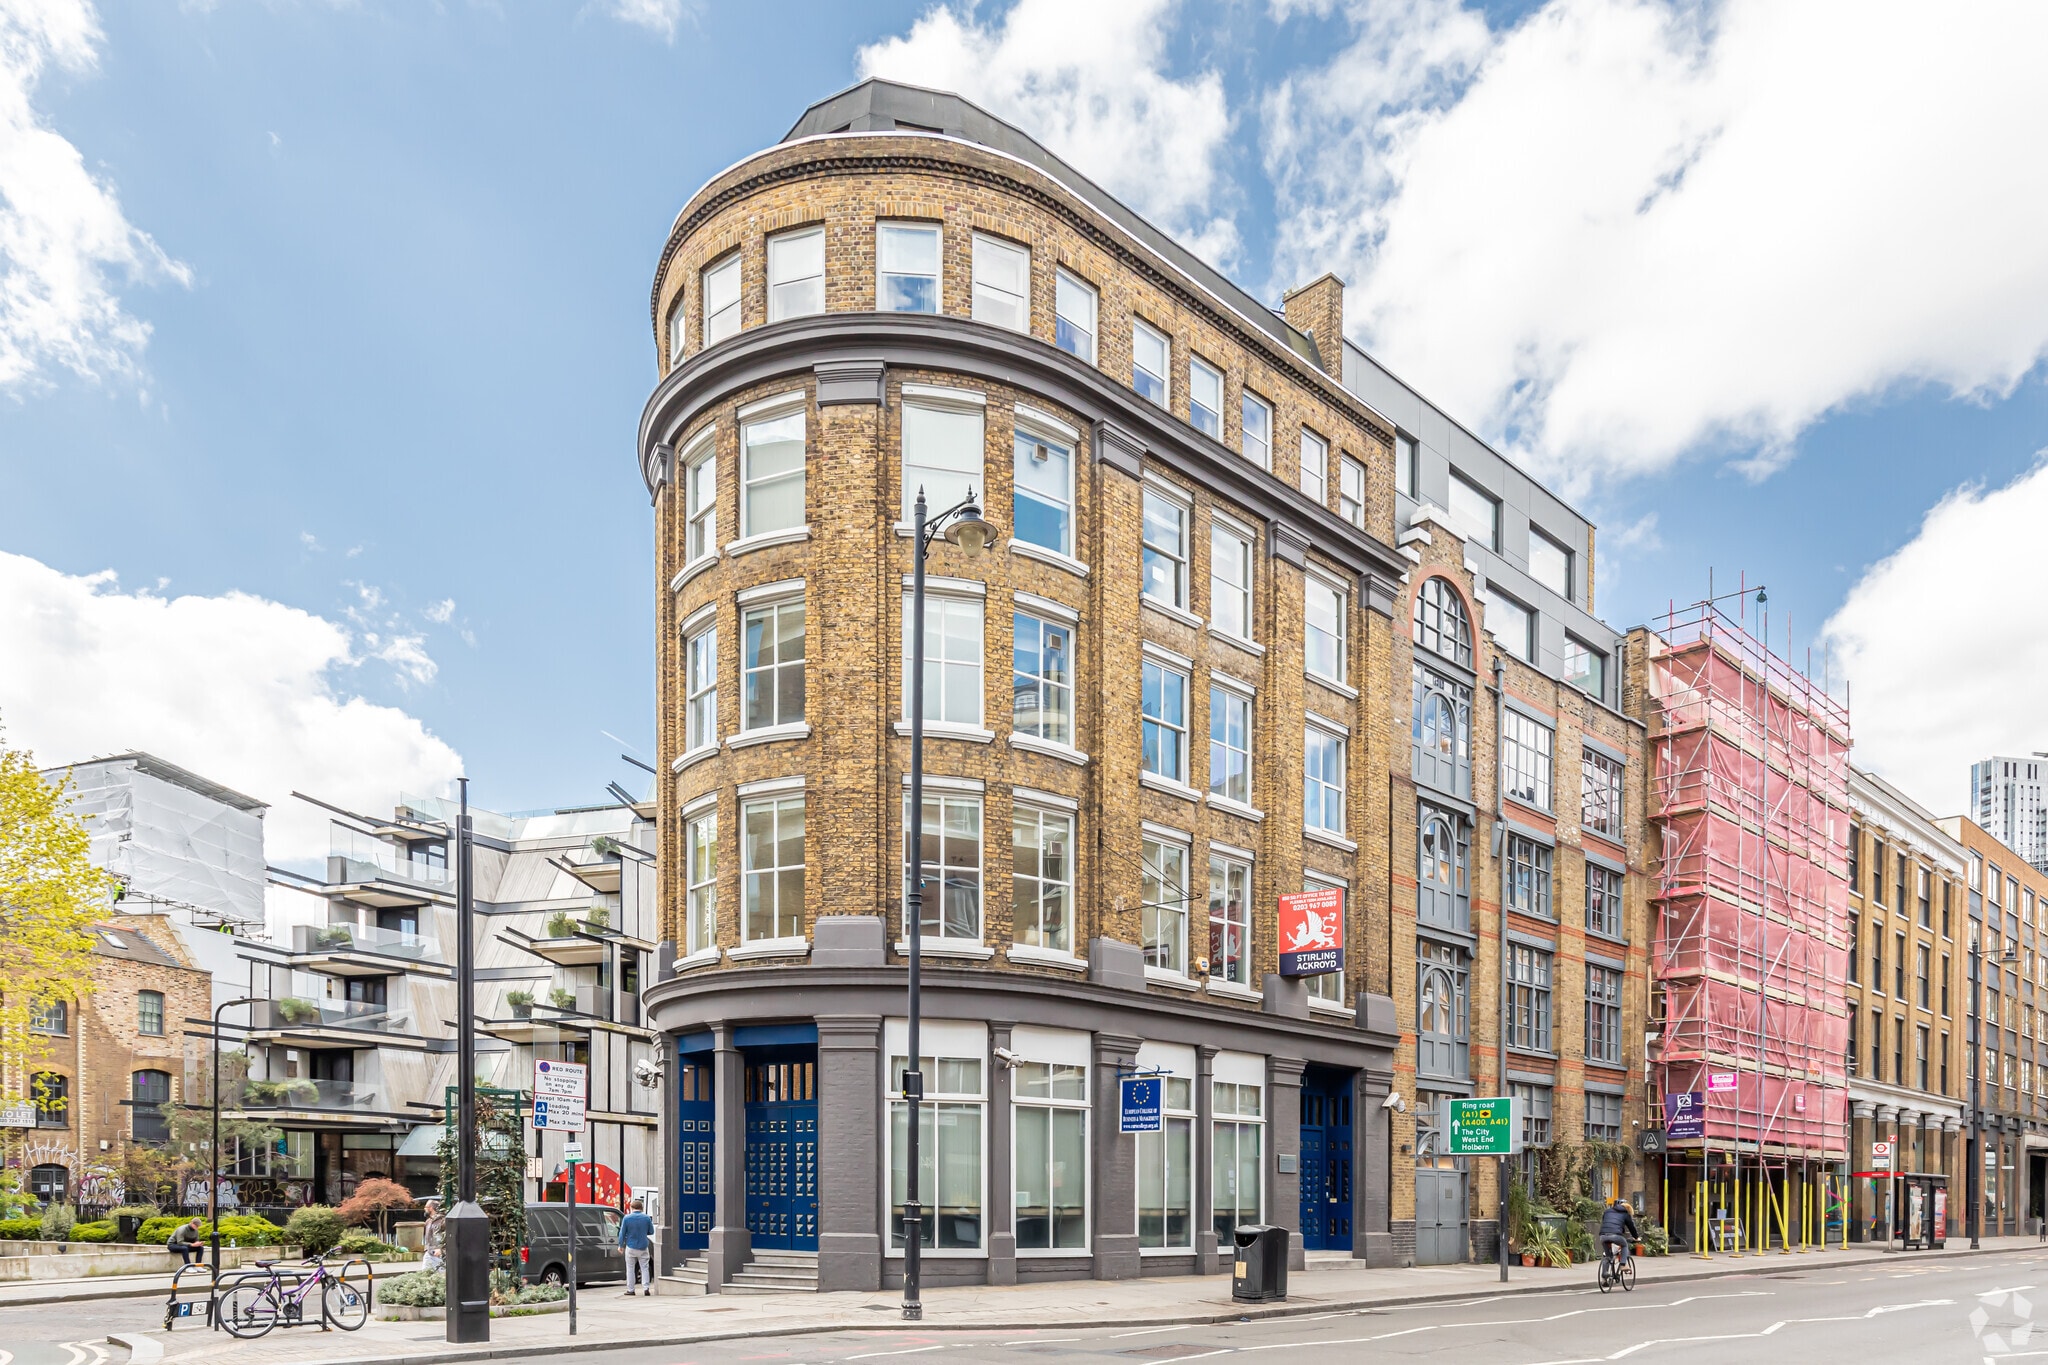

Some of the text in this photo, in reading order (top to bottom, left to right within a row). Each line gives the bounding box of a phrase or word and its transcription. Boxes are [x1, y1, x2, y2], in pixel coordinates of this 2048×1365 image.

[1297, 952, 1336, 962] STIRLING
[1297, 960, 1336, 971] ACKROYD
[1462, 1110, 1478, 1118] (A1)
[1476, 1128, 1490, 1136] City
[180, 1304, 189, 1316] P
